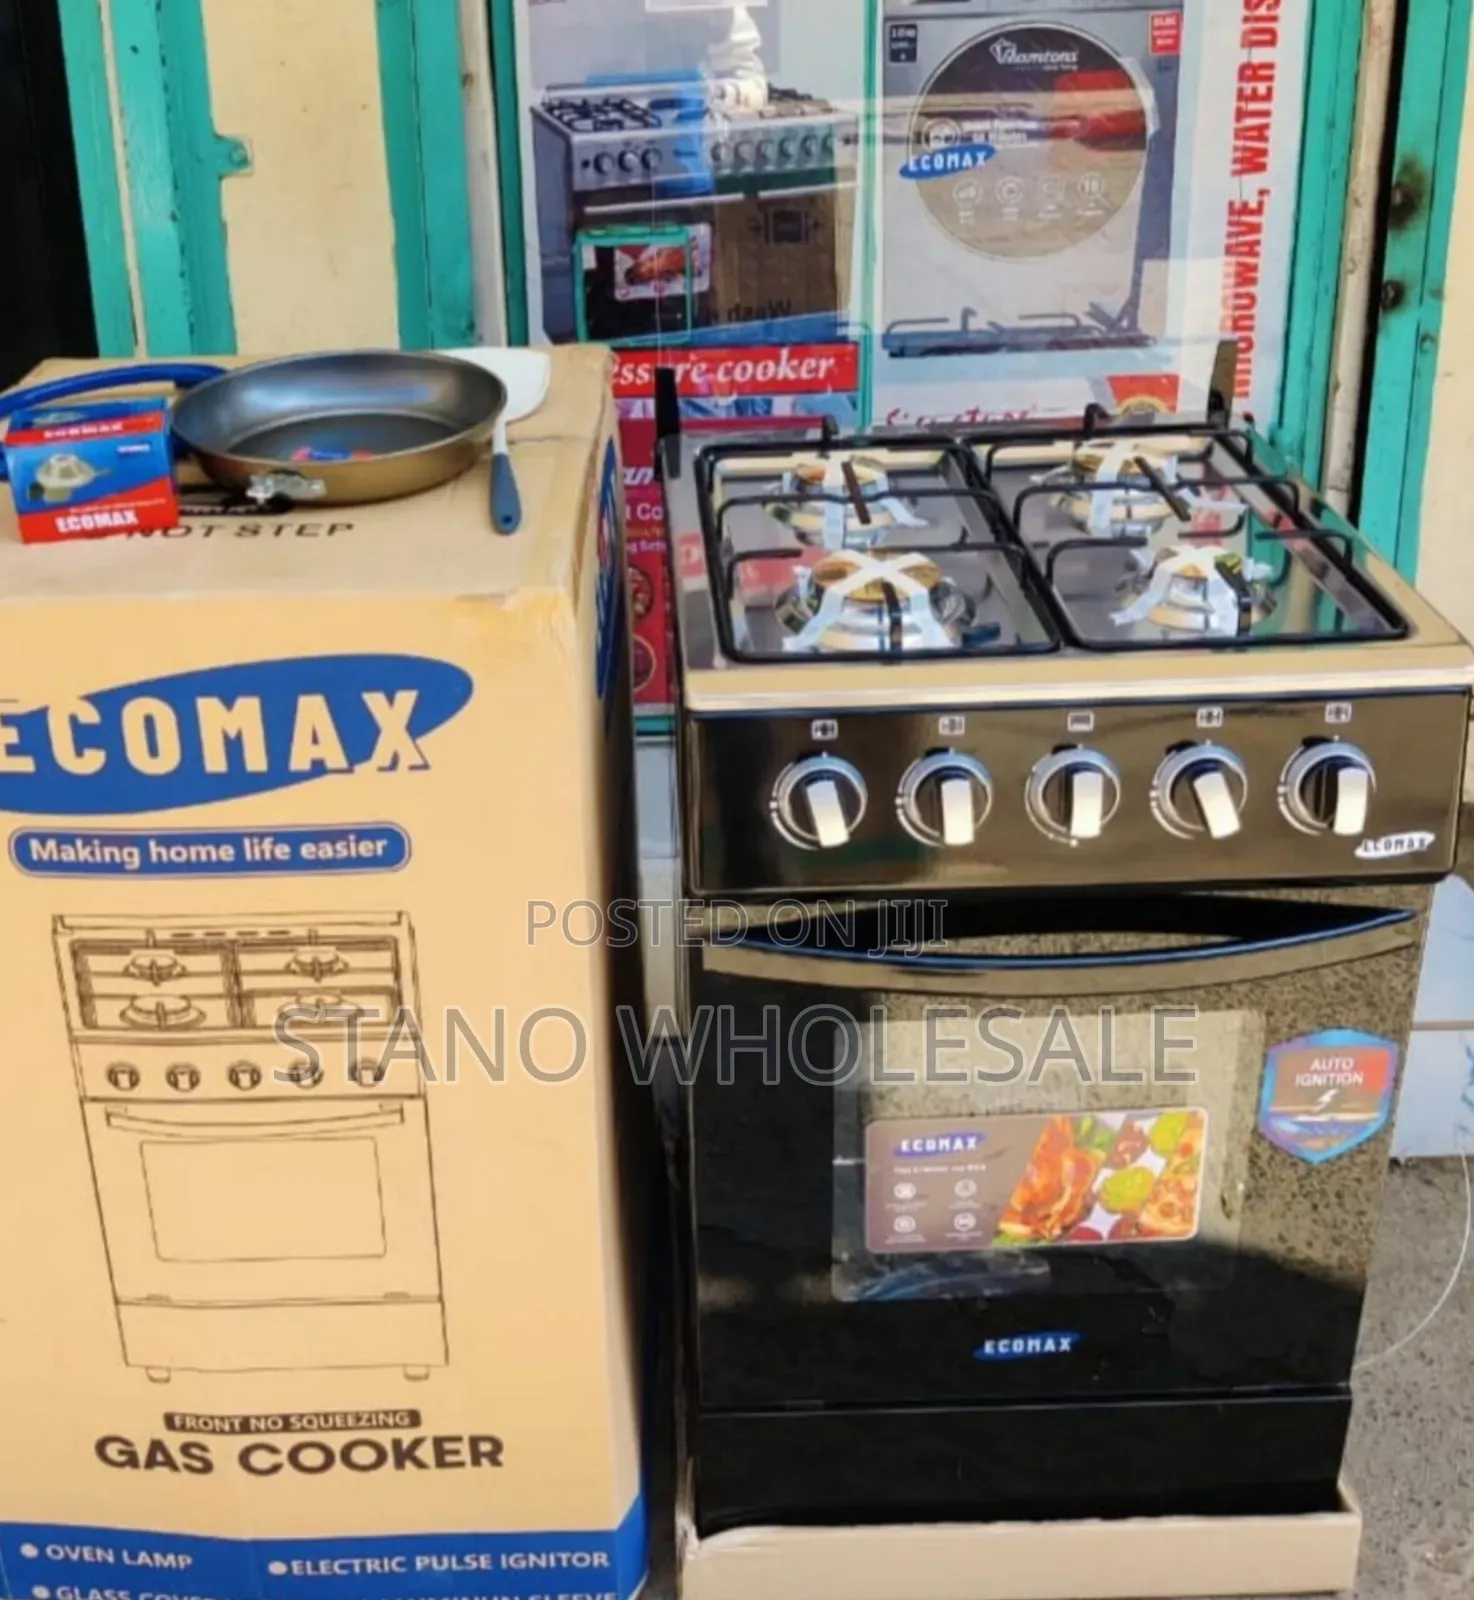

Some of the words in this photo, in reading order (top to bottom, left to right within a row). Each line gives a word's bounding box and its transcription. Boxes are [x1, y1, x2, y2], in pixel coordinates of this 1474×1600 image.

[1231, 61, 1275, 177] WATER
[906, 152, 989, 173] ECOMAX
[612, 357, 707, 387] ssre
[716, 348, 836, 383] cooker
[55, 510, 139, 534] ECOMAX
[234, 521, 355, 538] STEP
[0, 689, 431, 776] ECOMAX
[29, 838, 141, 869] Making
[149, 839, 235, 863] home
[243, 836, 291, 861] life
[300, 834, 388, 860] easier
[1310, 1057, 1354, 1071] AUTO
[1295, 1071, 1364, 1087] IGNITION
[900, 1136, 979, 1153] ECOMAX
[984, 1336, 1072, 1355] ECOMAX
[173, 1415, 244, 1433] FRONT
[250, 1415, 285, 1431] NO
[289, 1410, 412, 1431] SQUEEZING
[95, 1435, 215, 1475] GAS
[238, 1434, 505, 1477] COOKER
[46, 1545, 115, 1564] OVEN
[122, 1550, 193, 1570] LAMP
[291, 1556, 407, 1576] ELECTRIC
[415, 1554, 493, 1572] PULSE
[500, 1551, 610, 1569] IGNITOR
[55, 1585, 132, 1600] GLASS
